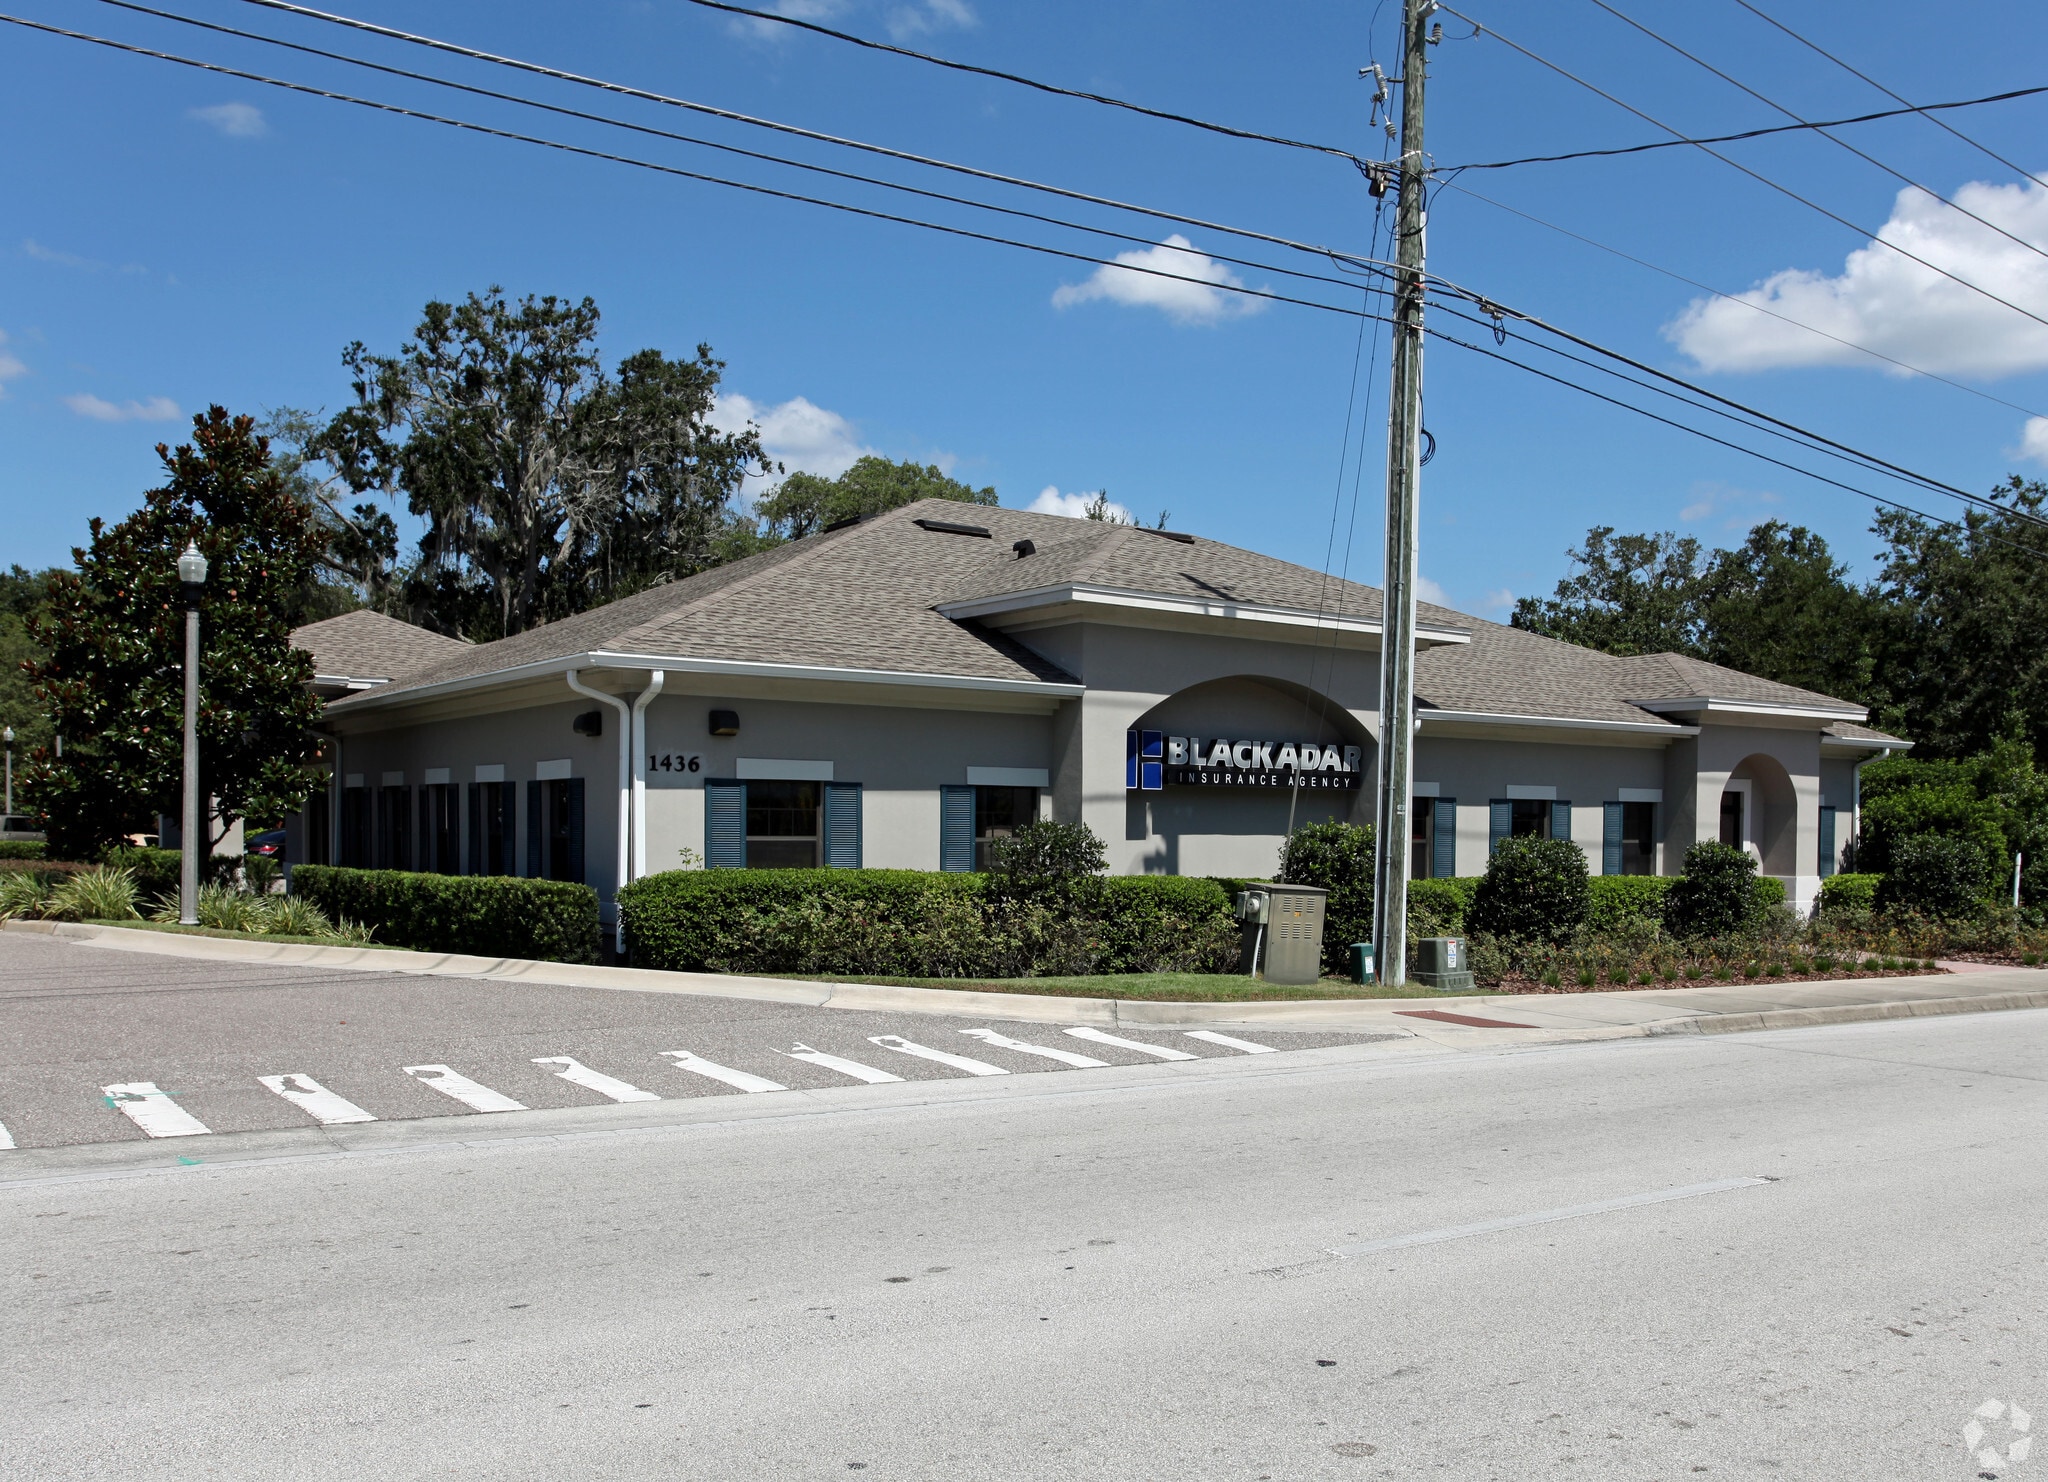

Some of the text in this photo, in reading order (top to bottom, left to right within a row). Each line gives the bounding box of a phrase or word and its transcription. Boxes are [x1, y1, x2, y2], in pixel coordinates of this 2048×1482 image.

[649, 754, 700, 773] 1436
[1168, 736, 1362, 772] BLACKADAR
[1179, 772, 1350, 788] INSURANCE AGENCY
